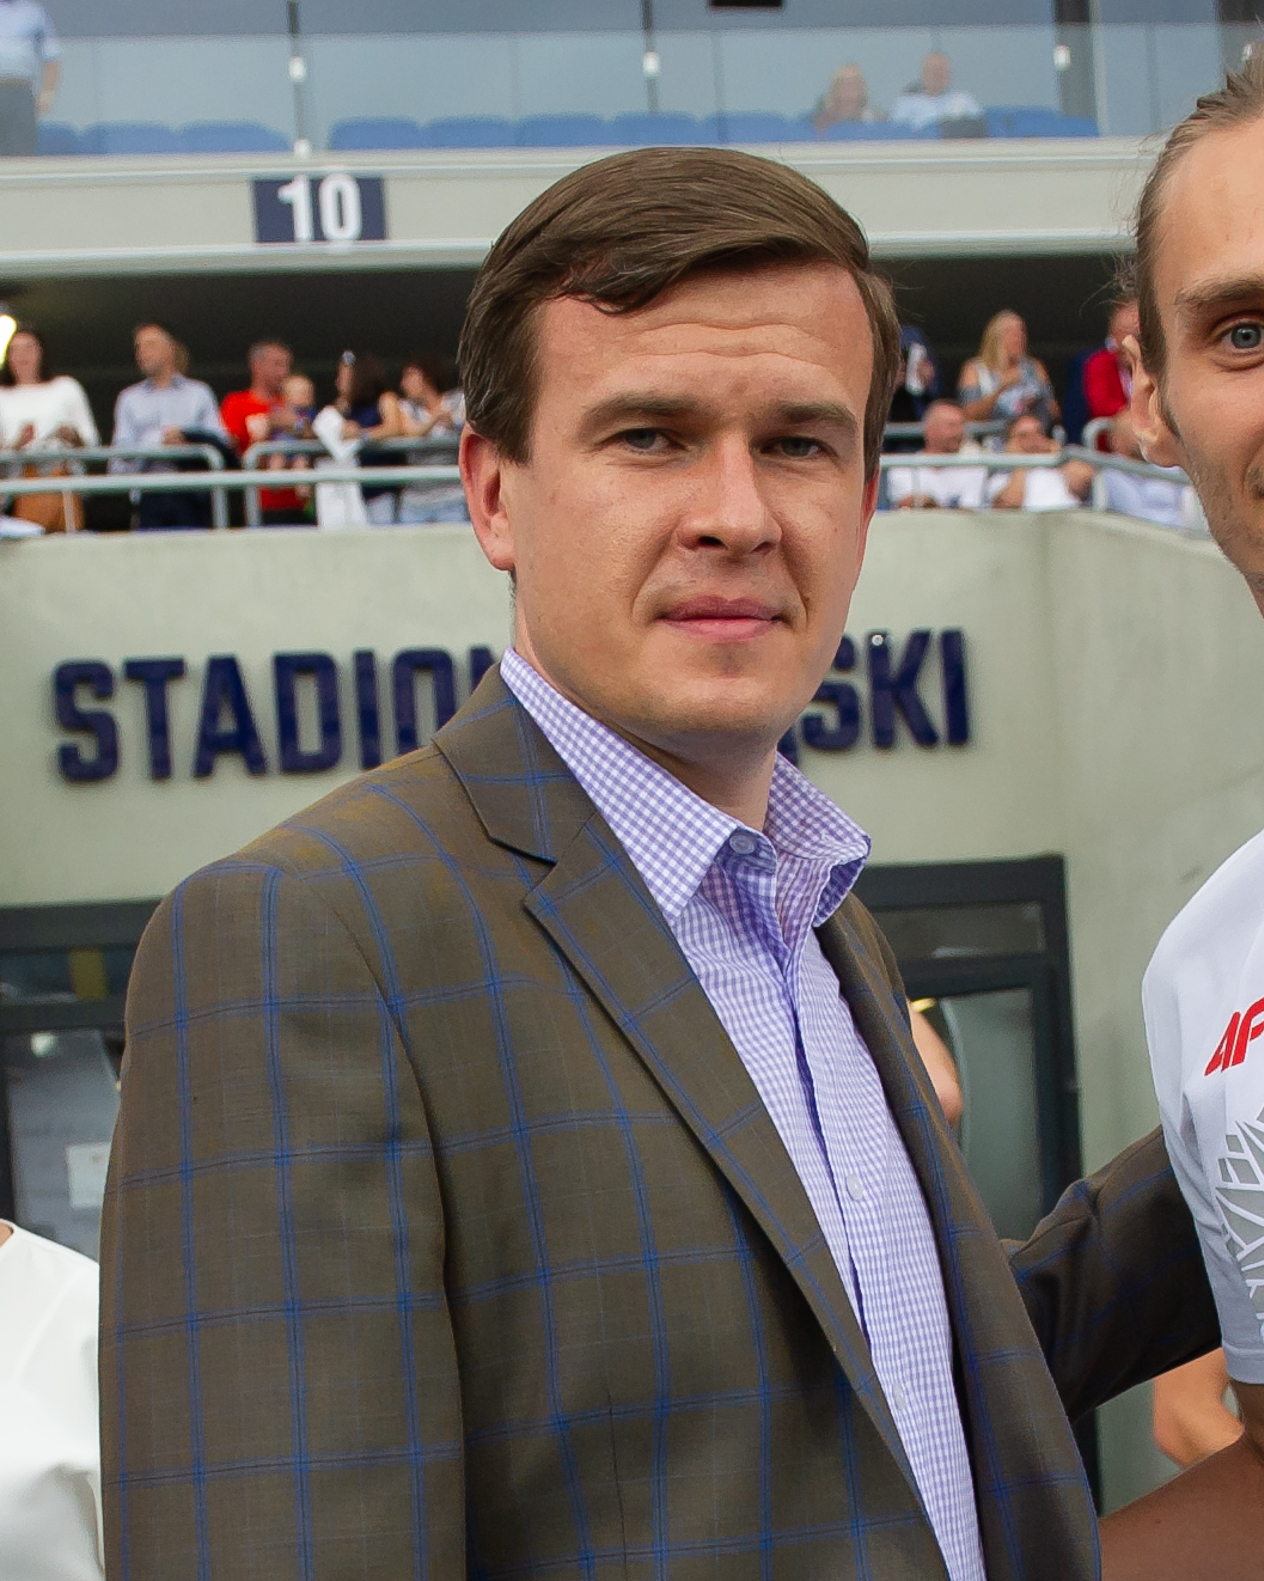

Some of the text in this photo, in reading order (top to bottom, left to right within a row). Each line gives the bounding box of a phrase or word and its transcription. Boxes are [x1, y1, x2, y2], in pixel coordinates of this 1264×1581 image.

[277, 173, 361, 242] 10
[53, 627, 968, 782] STADIO SKI
